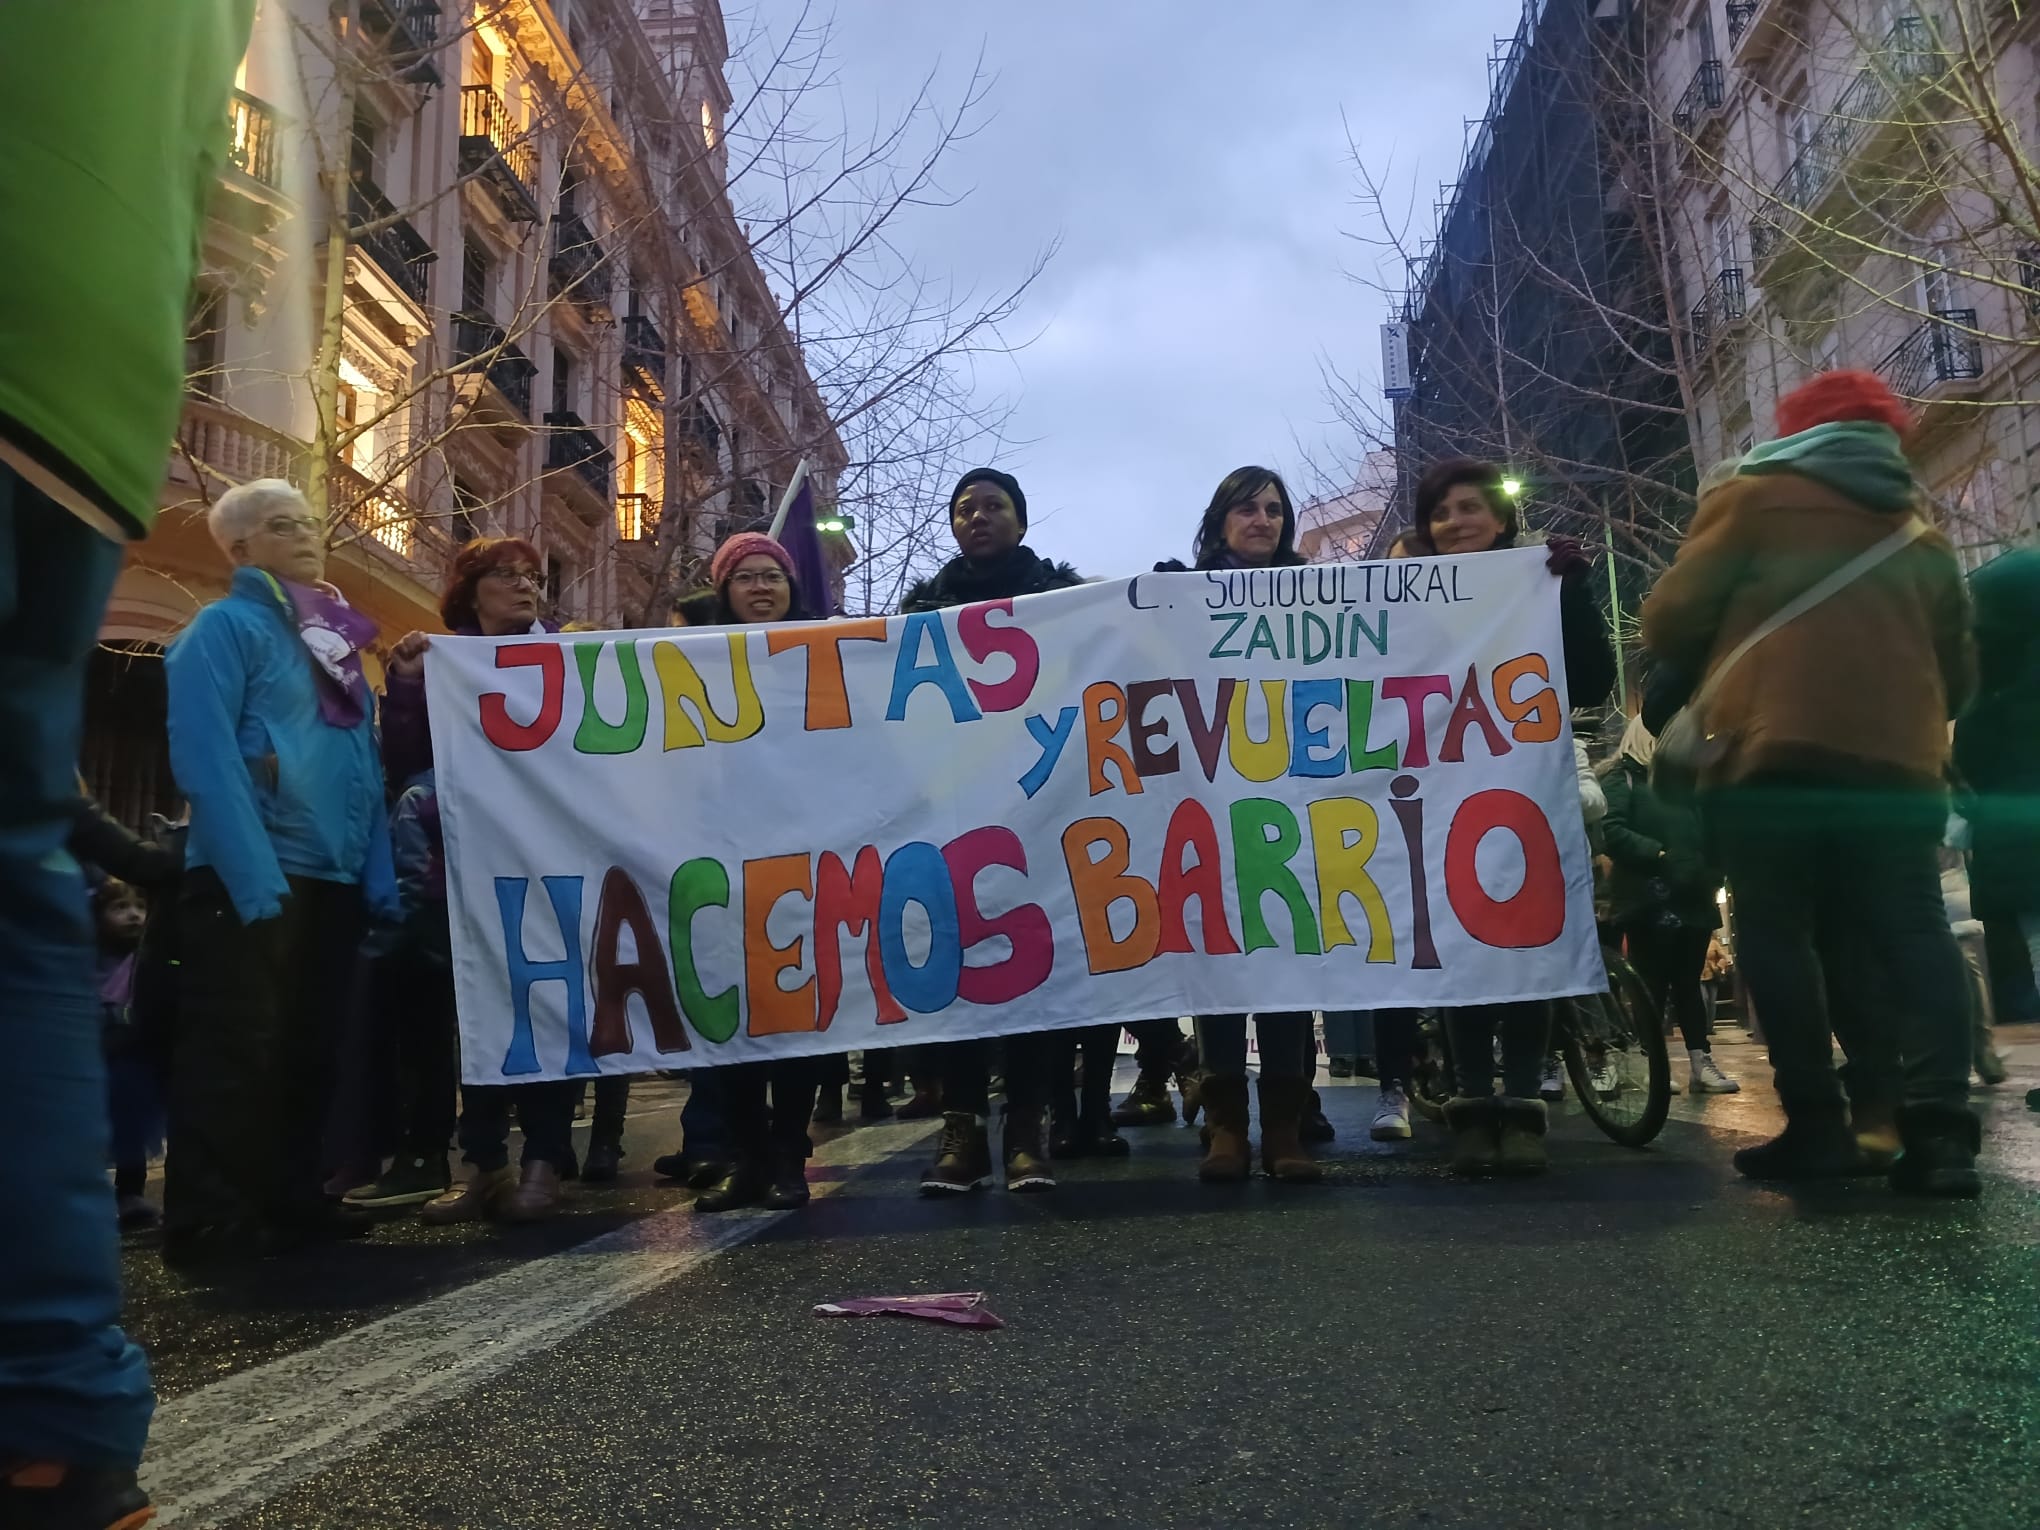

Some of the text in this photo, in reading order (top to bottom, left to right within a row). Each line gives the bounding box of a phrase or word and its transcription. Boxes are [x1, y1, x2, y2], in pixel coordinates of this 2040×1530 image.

[1127, 563, 1474, 610] C. SOCIOCULTURAL
[1208, 605, 1389, 666] ZAIDÍN
[478, 596, 1040, 755] JUNTAS
[1084, 652, 1563, 797] REVUELTAS
[493, 825, 1054, 1076] HACEMOS
